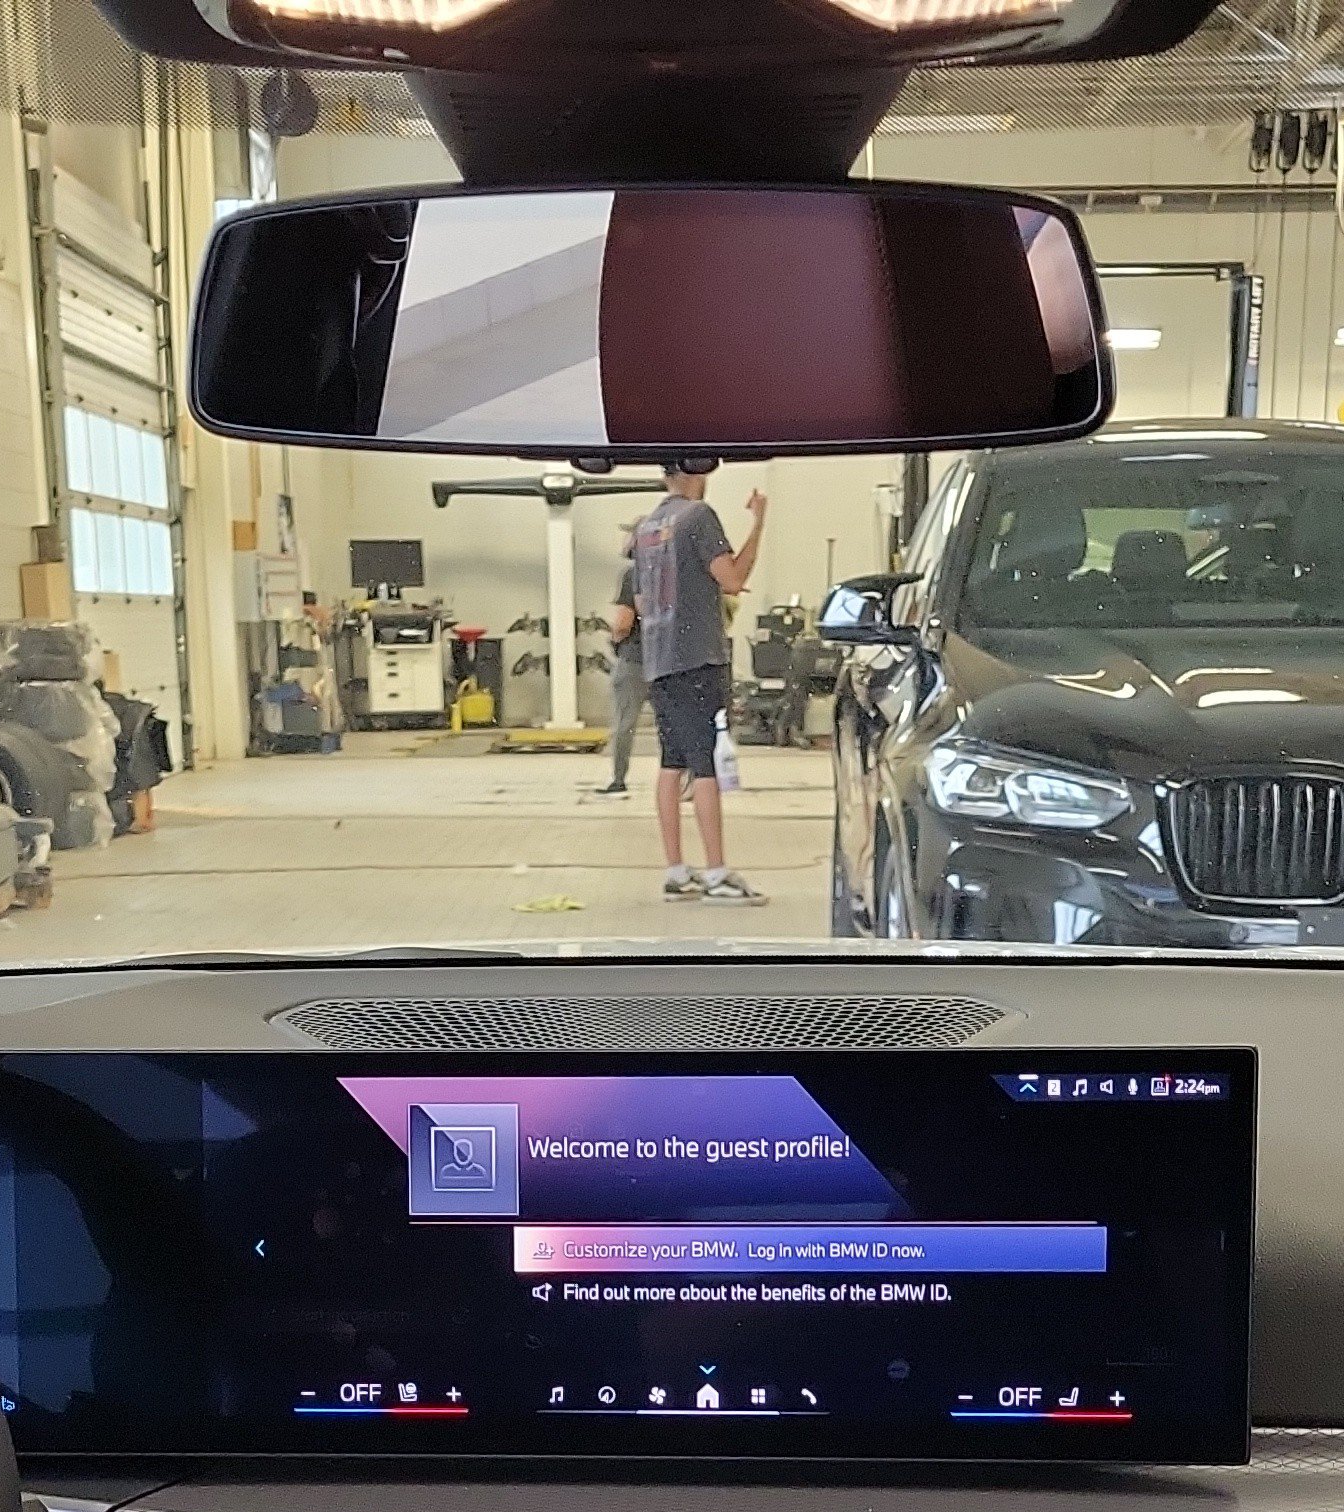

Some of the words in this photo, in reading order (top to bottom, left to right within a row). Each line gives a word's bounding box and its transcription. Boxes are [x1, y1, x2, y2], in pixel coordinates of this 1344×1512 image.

[527, 1136, 629, 1158] Welcome
[636, 1139, 657, 1158] to
[663, 1136, 699, 1158] the
[706, 1139, 768, 1163] guest
[775, 1136, 850, 1162] profile!
[563, 1241, 648, 1259] Customize
[650, 1245, 688, 1262] your
[691, 1242, 738, 1259] BMW.
[748, 1243, 776, 1261] Log
[795, 1243, 825, 1259] with
[829, 1243, 869, 1259] BMW
[872, 1243, 888, 1259] ID
[891, 1246, 926, 1259] now.
[563, 1283, 599, 1301] Find
[603, 1285, 631, 1301] out
[634, 1287, 676, 1301] more
[679, 1284, 727, 1301] about
[730, 1284, 757, 1301] the
[761, 1284, 826, 1301] benefits
[829, 1284, 848, 1301] of
[849, 1285, 876, 1301] the
[880, 1285, 927, 1301] BMW
[930, 1285, 952, 1301] ID.
[339, 1384, 382, 1402] OFF
[998, 1387, 1042, 1406] OFF
